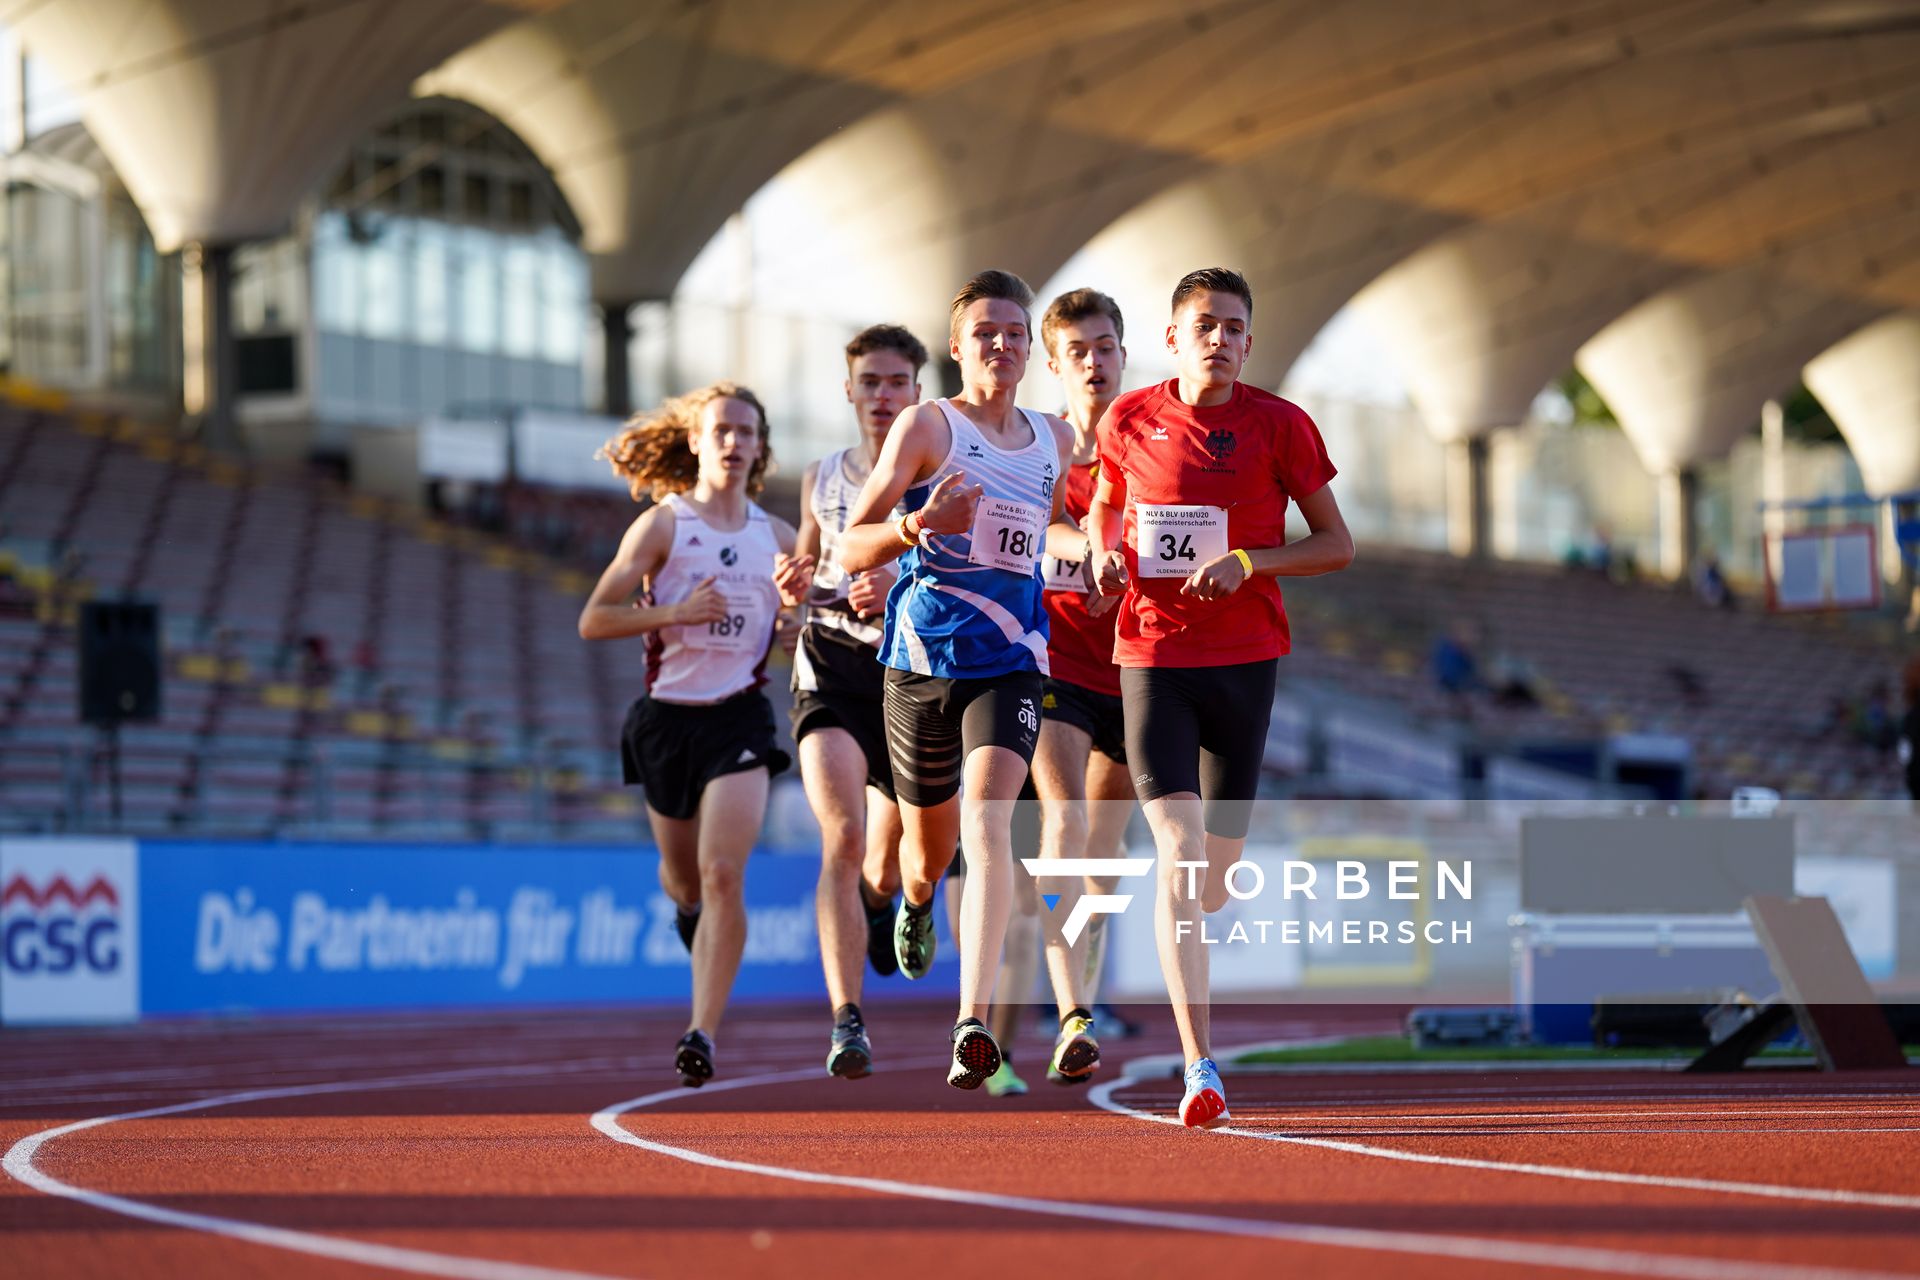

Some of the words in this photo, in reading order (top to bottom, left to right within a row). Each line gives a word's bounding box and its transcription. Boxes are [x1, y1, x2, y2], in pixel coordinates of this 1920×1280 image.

[996, 503, 1008, 511] NLV
[1180, 511, 1209, 519] U18/U20
[1159, 534, 1196, 561] 34
[994, 558, 1024, 570] OLDENBURG
[3, 917, 120, 974] GSG
[196, 889, 280, 971] Die
[289, 888, 499, 970] Partnerin
[501, 887, 574, 988] für
[577, 889, 645, 967] Ihr
